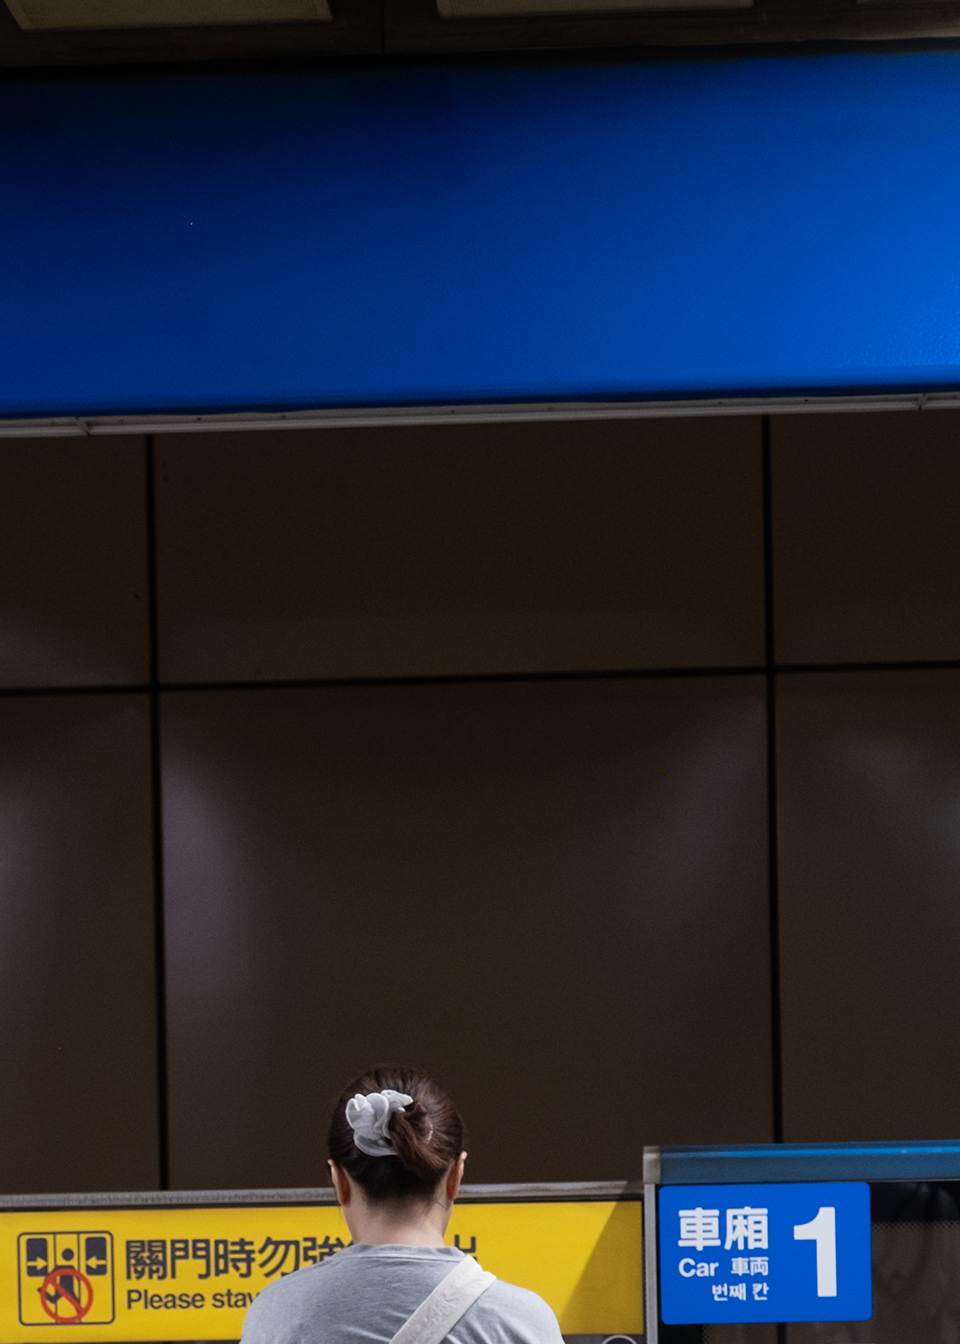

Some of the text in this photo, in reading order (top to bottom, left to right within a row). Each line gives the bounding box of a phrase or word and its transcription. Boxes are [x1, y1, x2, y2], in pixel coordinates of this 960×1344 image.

[125, 1233, 477, 1280] 關門時勿強
[678, 1206, 837, 1297] 車廂 1
[678, 1256, 769, 1277] Car 車両
[127, 1289, 206, 1310] Please
[712, 1282, 769, 1301] 번째 칸
